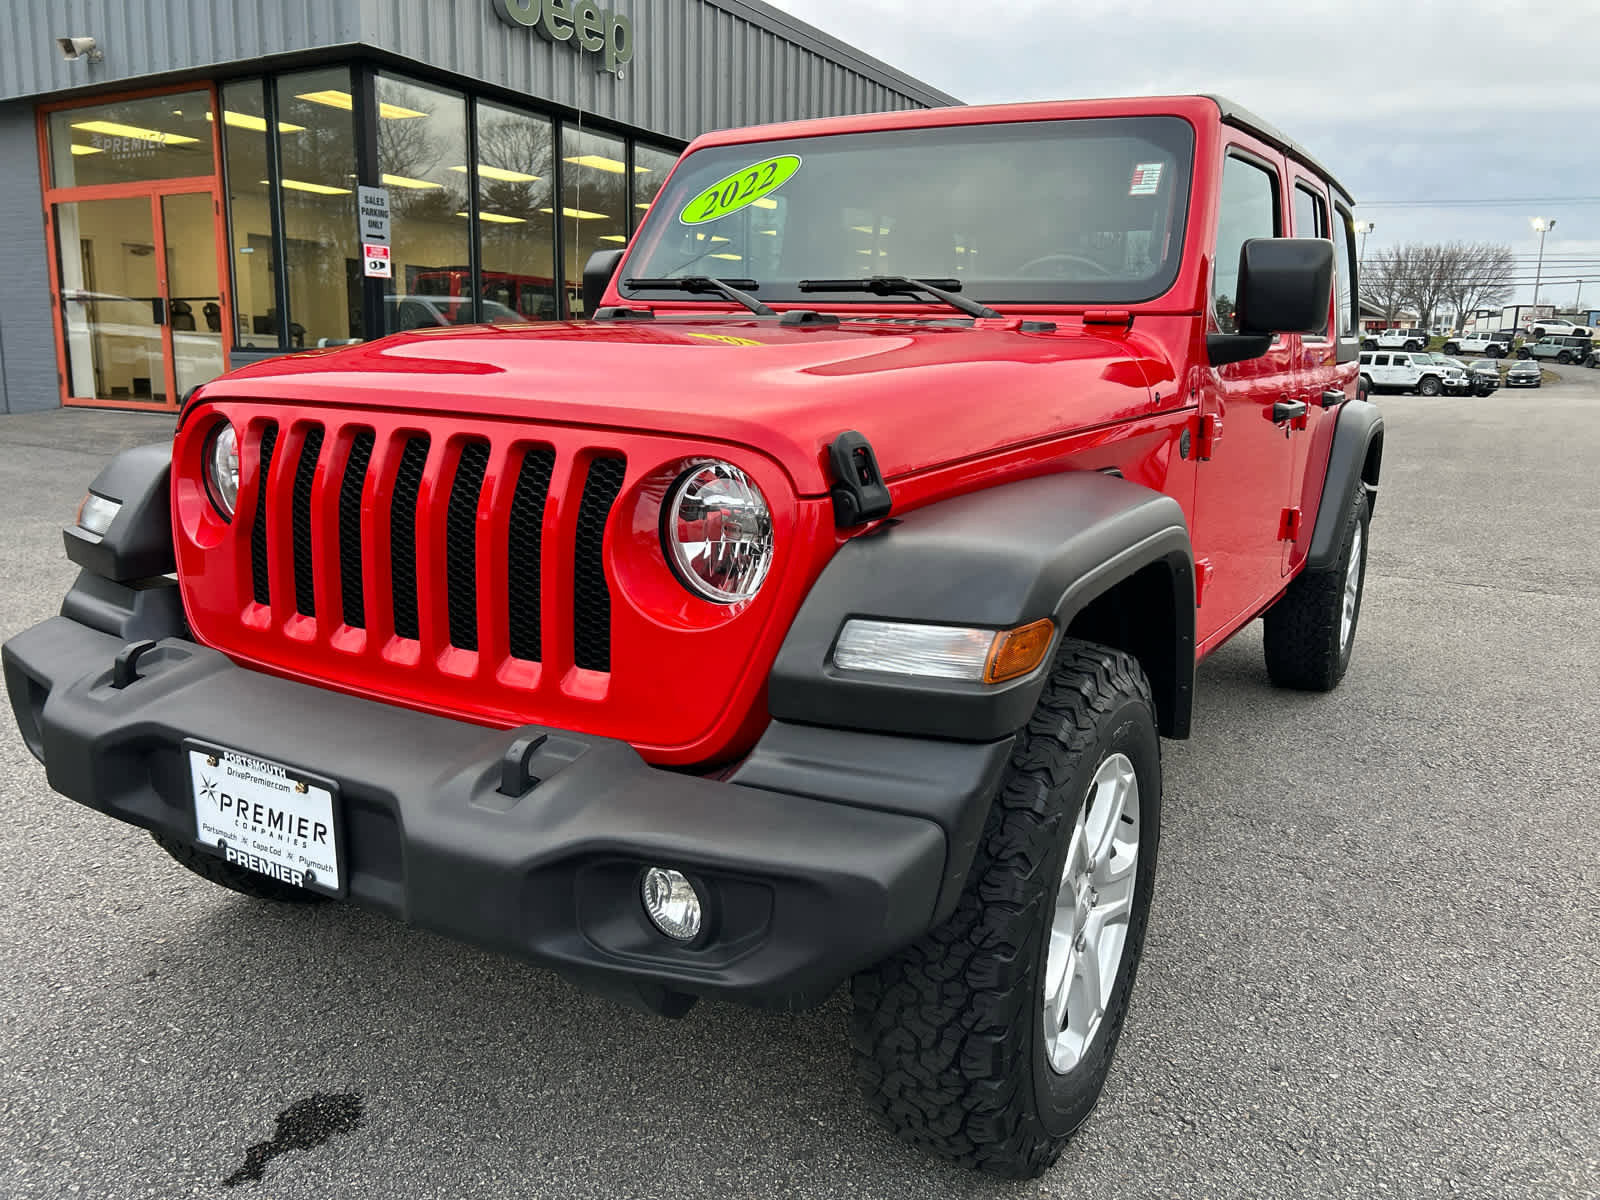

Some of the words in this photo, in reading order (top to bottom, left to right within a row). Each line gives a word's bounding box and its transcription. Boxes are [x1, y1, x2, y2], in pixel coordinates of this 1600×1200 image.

[103, 132, 167, 153] PREMIER
[364, 195, 385, 206] SALES
[699, 162, 778, 219] 2022
[361, 207, 389, 218] PARKING
[368, 219, 384, 230] ONLY
[224, 751, 287, 779] PORTSMOUTH
[226, 766, 291, 793] DrivePremier.com
[220, 792, 328, 845] PREMIER
[202, 822, 238, 841] Portsmouth
[252, 840, 268, 853] Cape
[269, 846, 281, 857] Cod
[299, 855, 334, 873] Plymouth
[234, 820, 308, 849] COMPANIES
[226, 847, 304, 888] PREMIER
